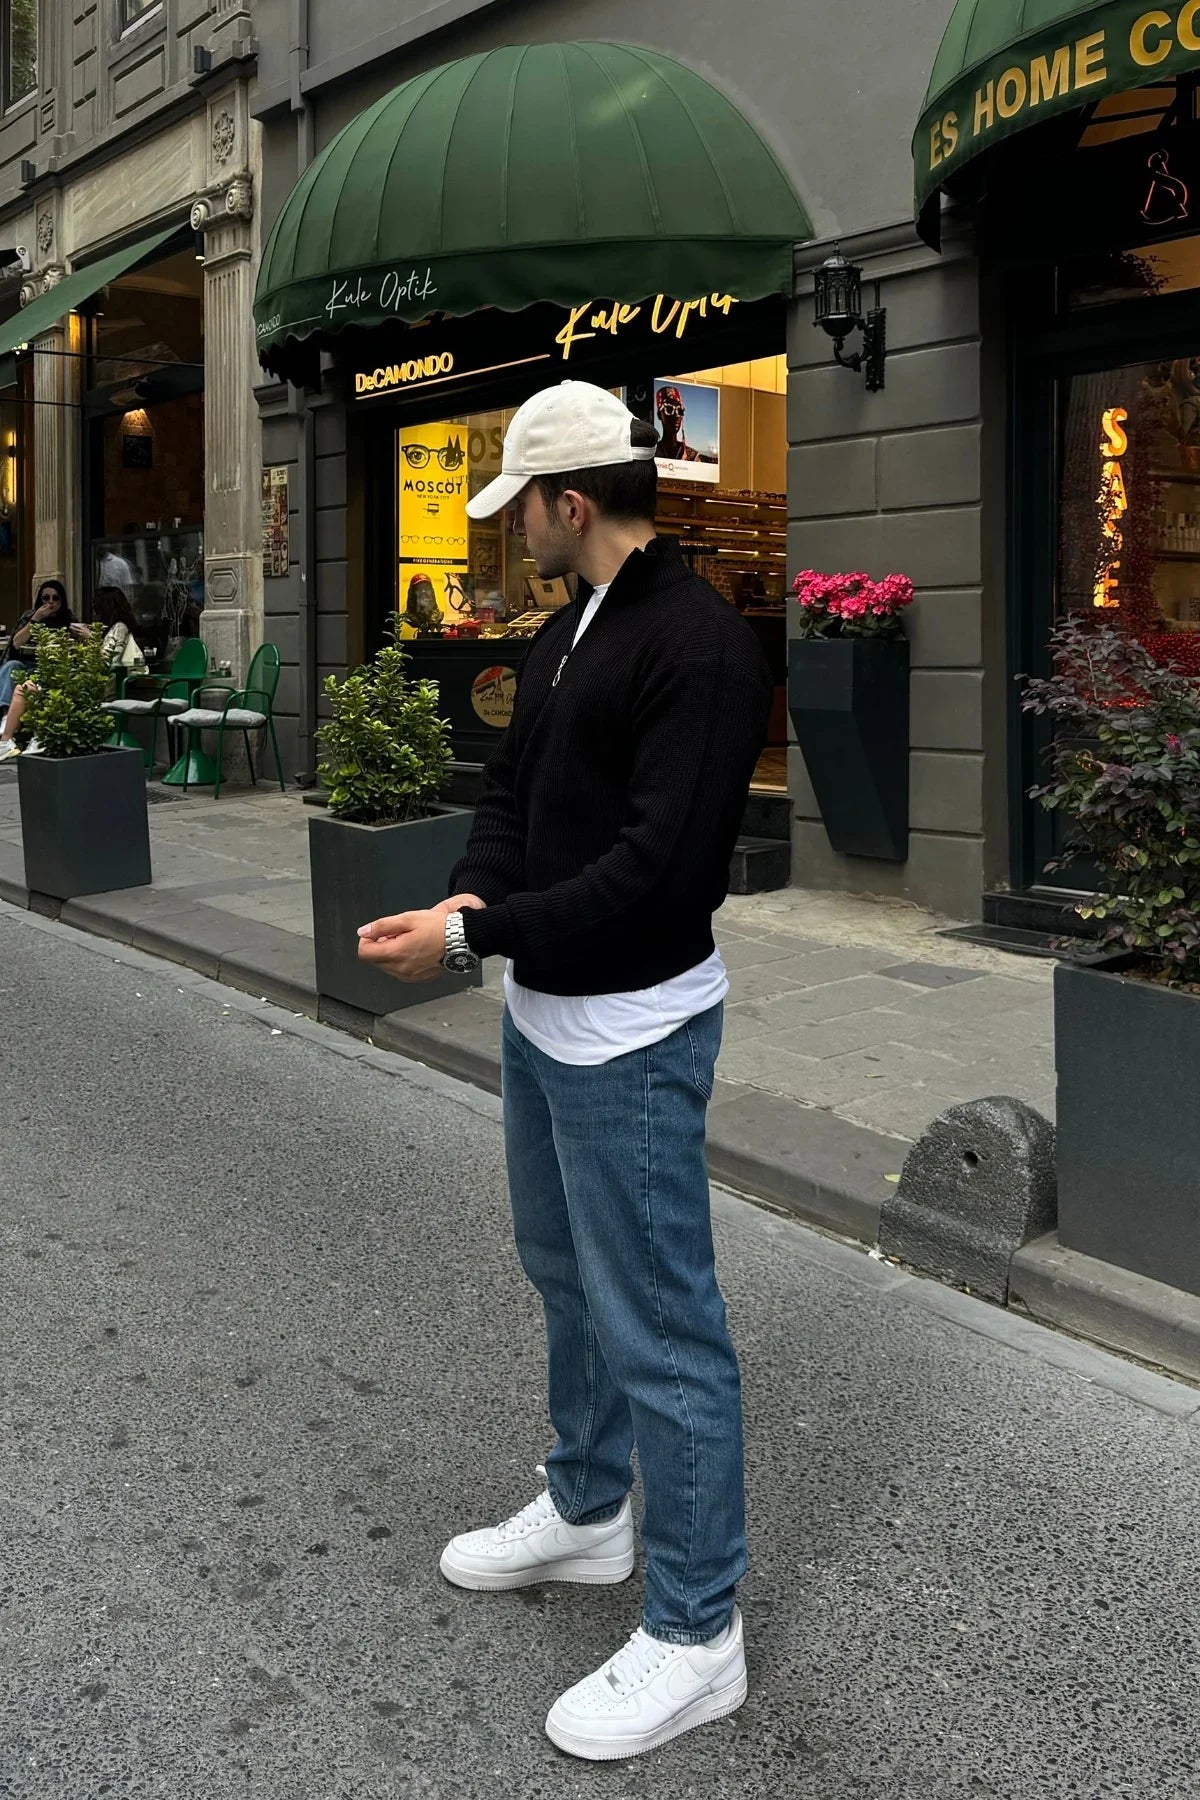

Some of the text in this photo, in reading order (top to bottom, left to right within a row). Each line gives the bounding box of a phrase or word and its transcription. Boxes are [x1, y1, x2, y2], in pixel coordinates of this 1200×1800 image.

[930, 110, 959, 170] ES
[973, 29, 1107, 137] HOME
[325, 267, 437, 320] Kule Optik
[555, 300, 641, 360] Kule
[355, 351, 454, 393] DeCAMONDO
[403, 479, 462, 495] MOSCOT
